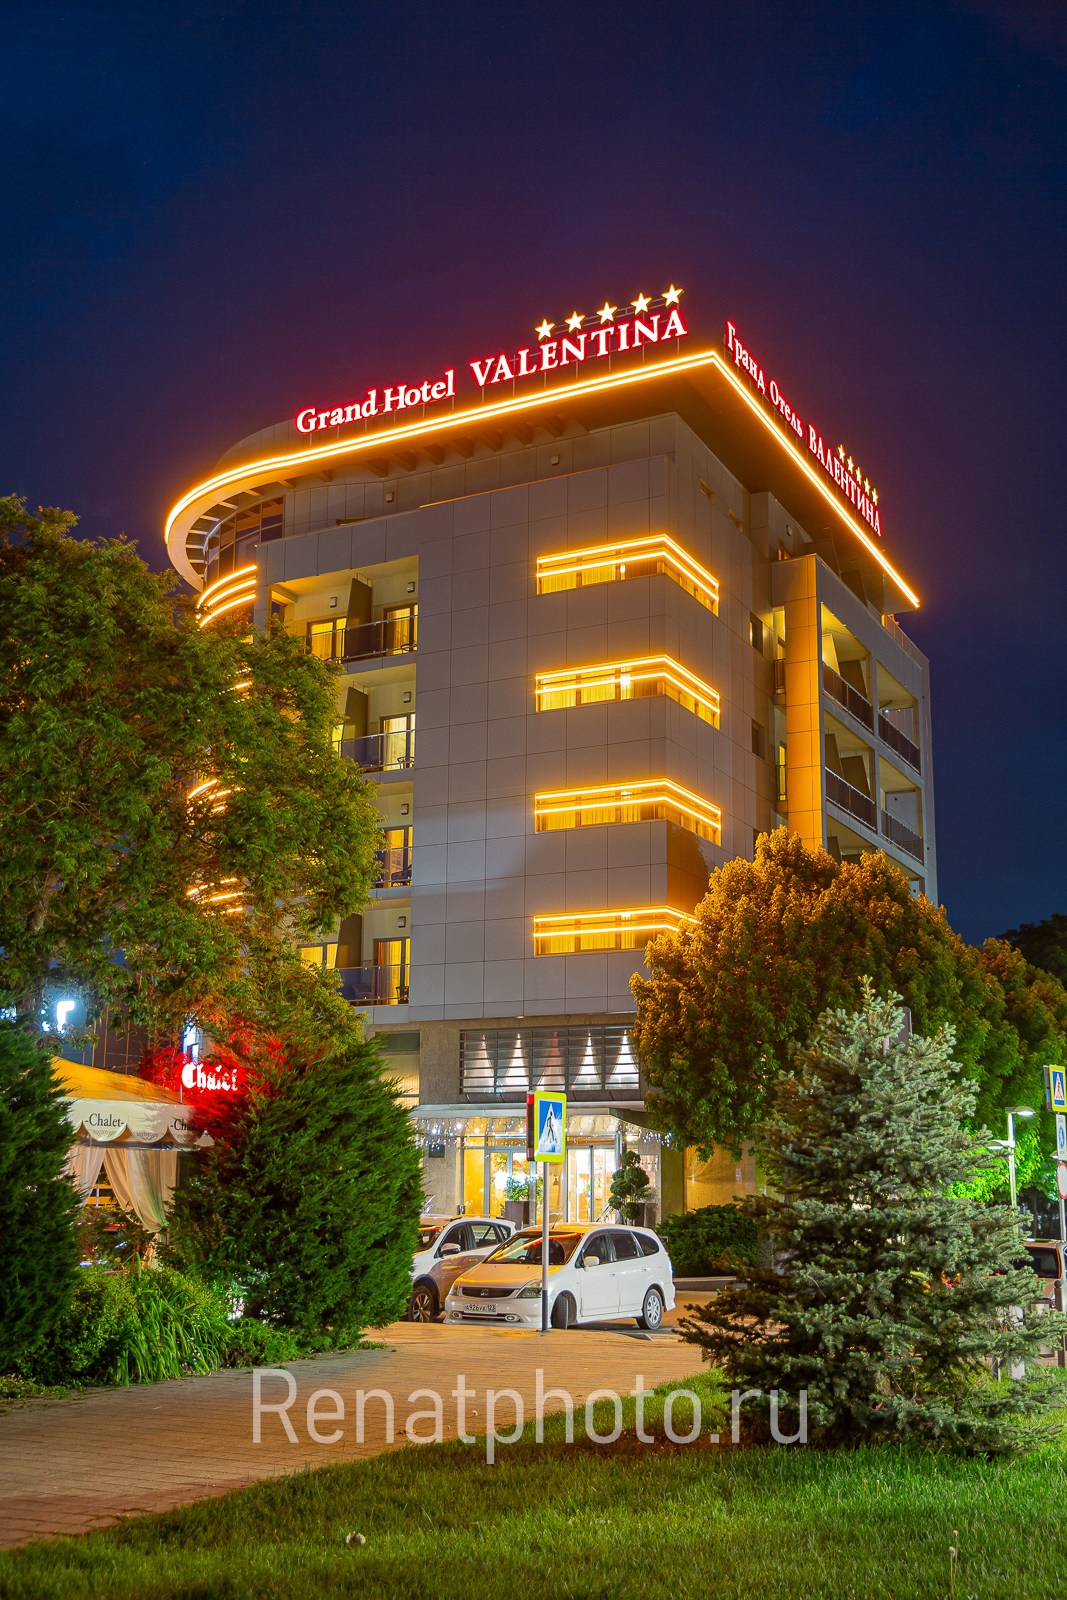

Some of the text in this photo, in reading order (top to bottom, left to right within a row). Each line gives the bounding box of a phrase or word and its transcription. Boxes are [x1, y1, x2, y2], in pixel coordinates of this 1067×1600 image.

[296, 309, 688, 433] Grand Hotel VALENTINA
[727, 321, 882, 537] Гранд Отель ВАЛЕНТИНА
